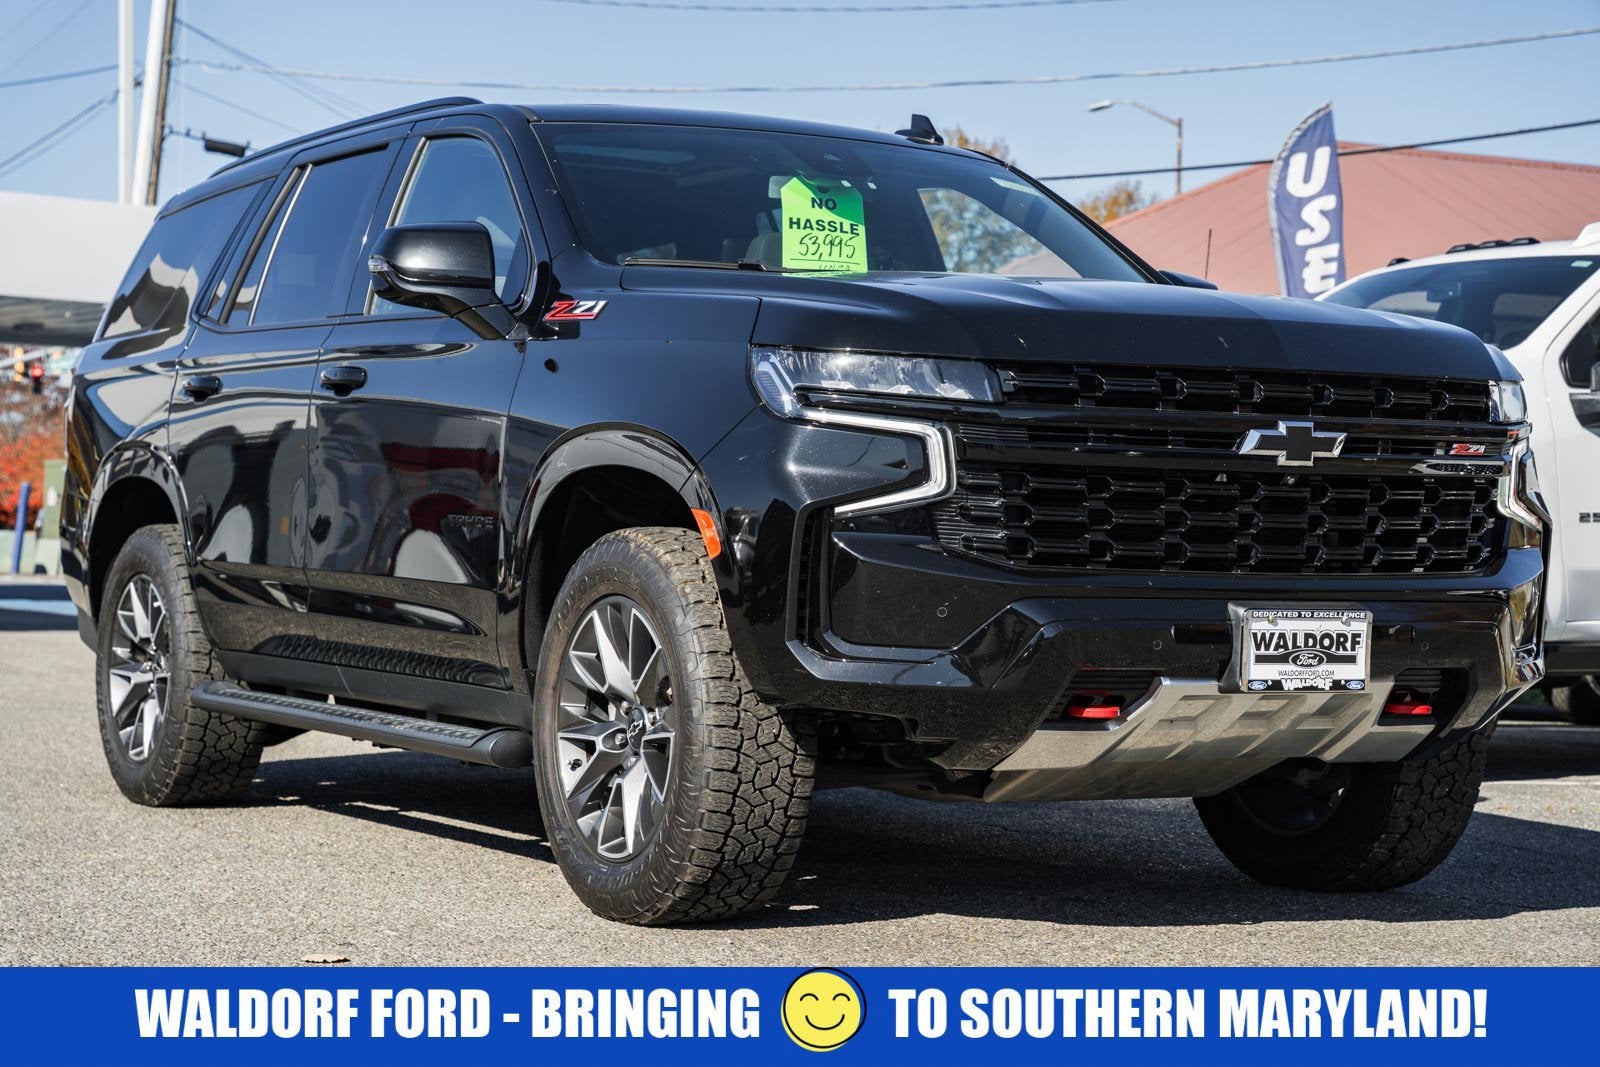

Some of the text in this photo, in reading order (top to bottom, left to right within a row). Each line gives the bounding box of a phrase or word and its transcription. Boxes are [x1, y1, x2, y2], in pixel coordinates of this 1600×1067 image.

[811, 197, 837, 210] NO
[788, 217, 859, 236] HASSLE
[798, 232, 860, 260] 53,995
[543, 300, 609, 320] Z71
[1449, 443, 1486, 455] Z71
[1252, 611, 1367, 619] DEDICATED TO EXCELLENCE
[1250, 630, 1364, 653] WALDORF
[1296, 654, 1320, 667] Ford
[1278, 669, 1335, 677] WALDORFFORD.COM
[1280, 678, 1333, 691] WALDORF
